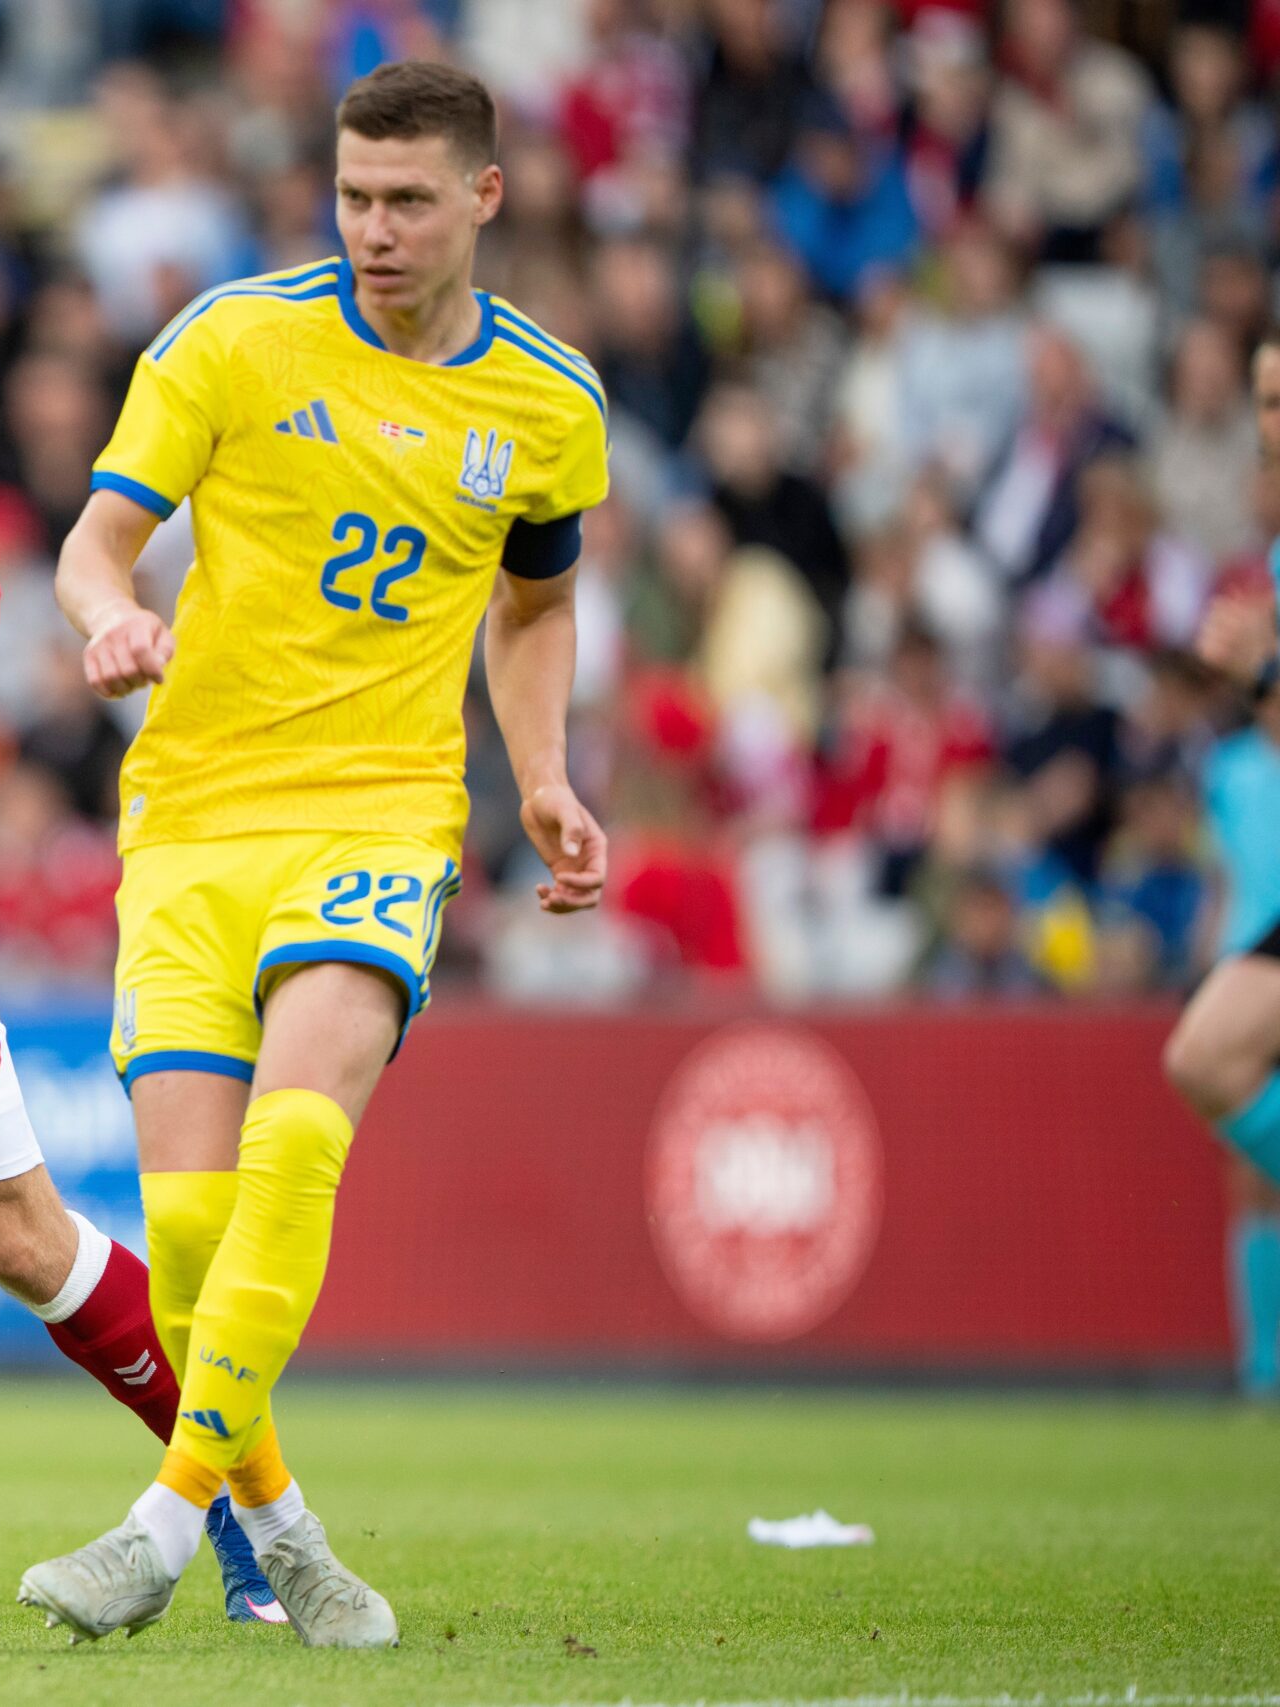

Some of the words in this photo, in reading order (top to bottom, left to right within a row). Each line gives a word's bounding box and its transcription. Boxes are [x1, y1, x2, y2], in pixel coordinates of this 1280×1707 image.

[320, 511, 427, 622] 22
[320, 870, 423, 939] 22
[199, 1345, 259, 1384] UAF
